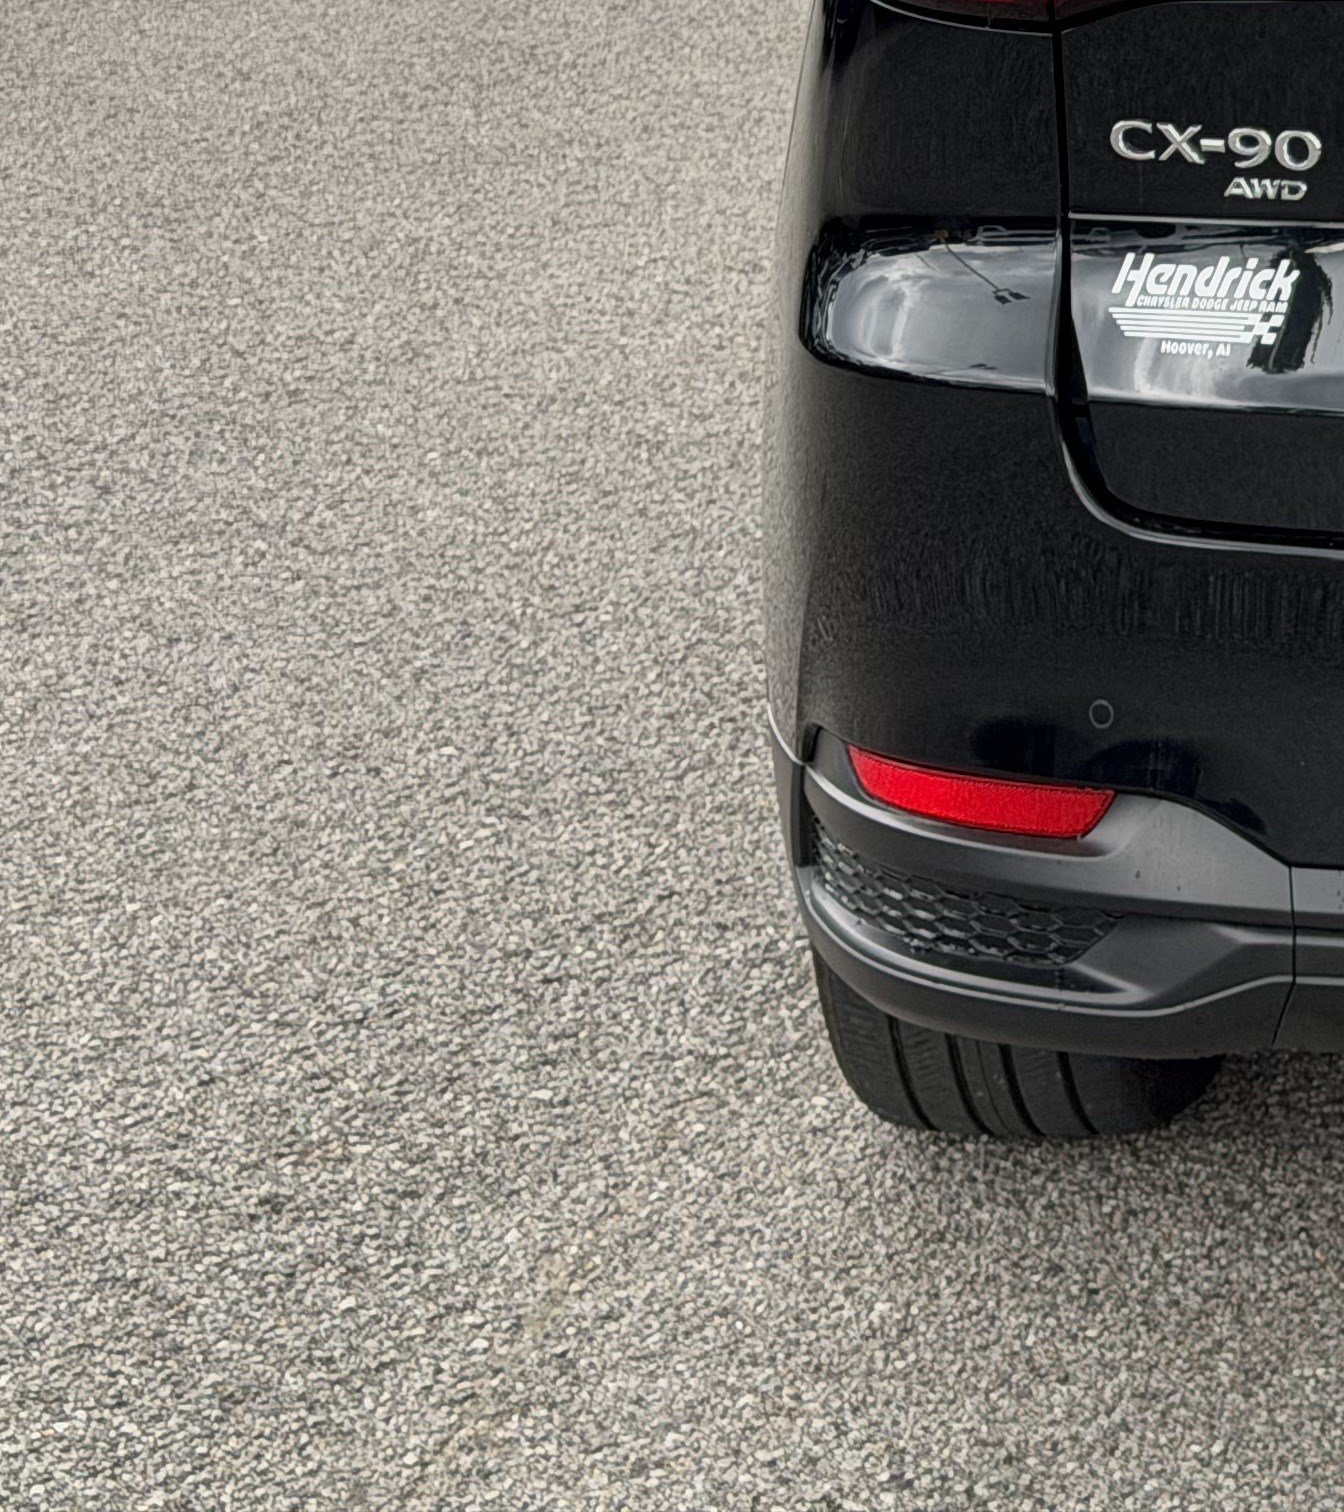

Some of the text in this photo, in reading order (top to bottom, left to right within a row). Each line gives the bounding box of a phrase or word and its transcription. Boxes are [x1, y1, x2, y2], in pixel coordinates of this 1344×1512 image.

[1109, 120, 1322, 171] CX-90
[1223, 177, 1308, 201] AWD
[1111, 252, 1301, 307] Hendrick
[1136, 295, 1289, 313] CHRYSLER DODGE JEEP RAM
[1160, 340, 1214, 359] Hoover,
